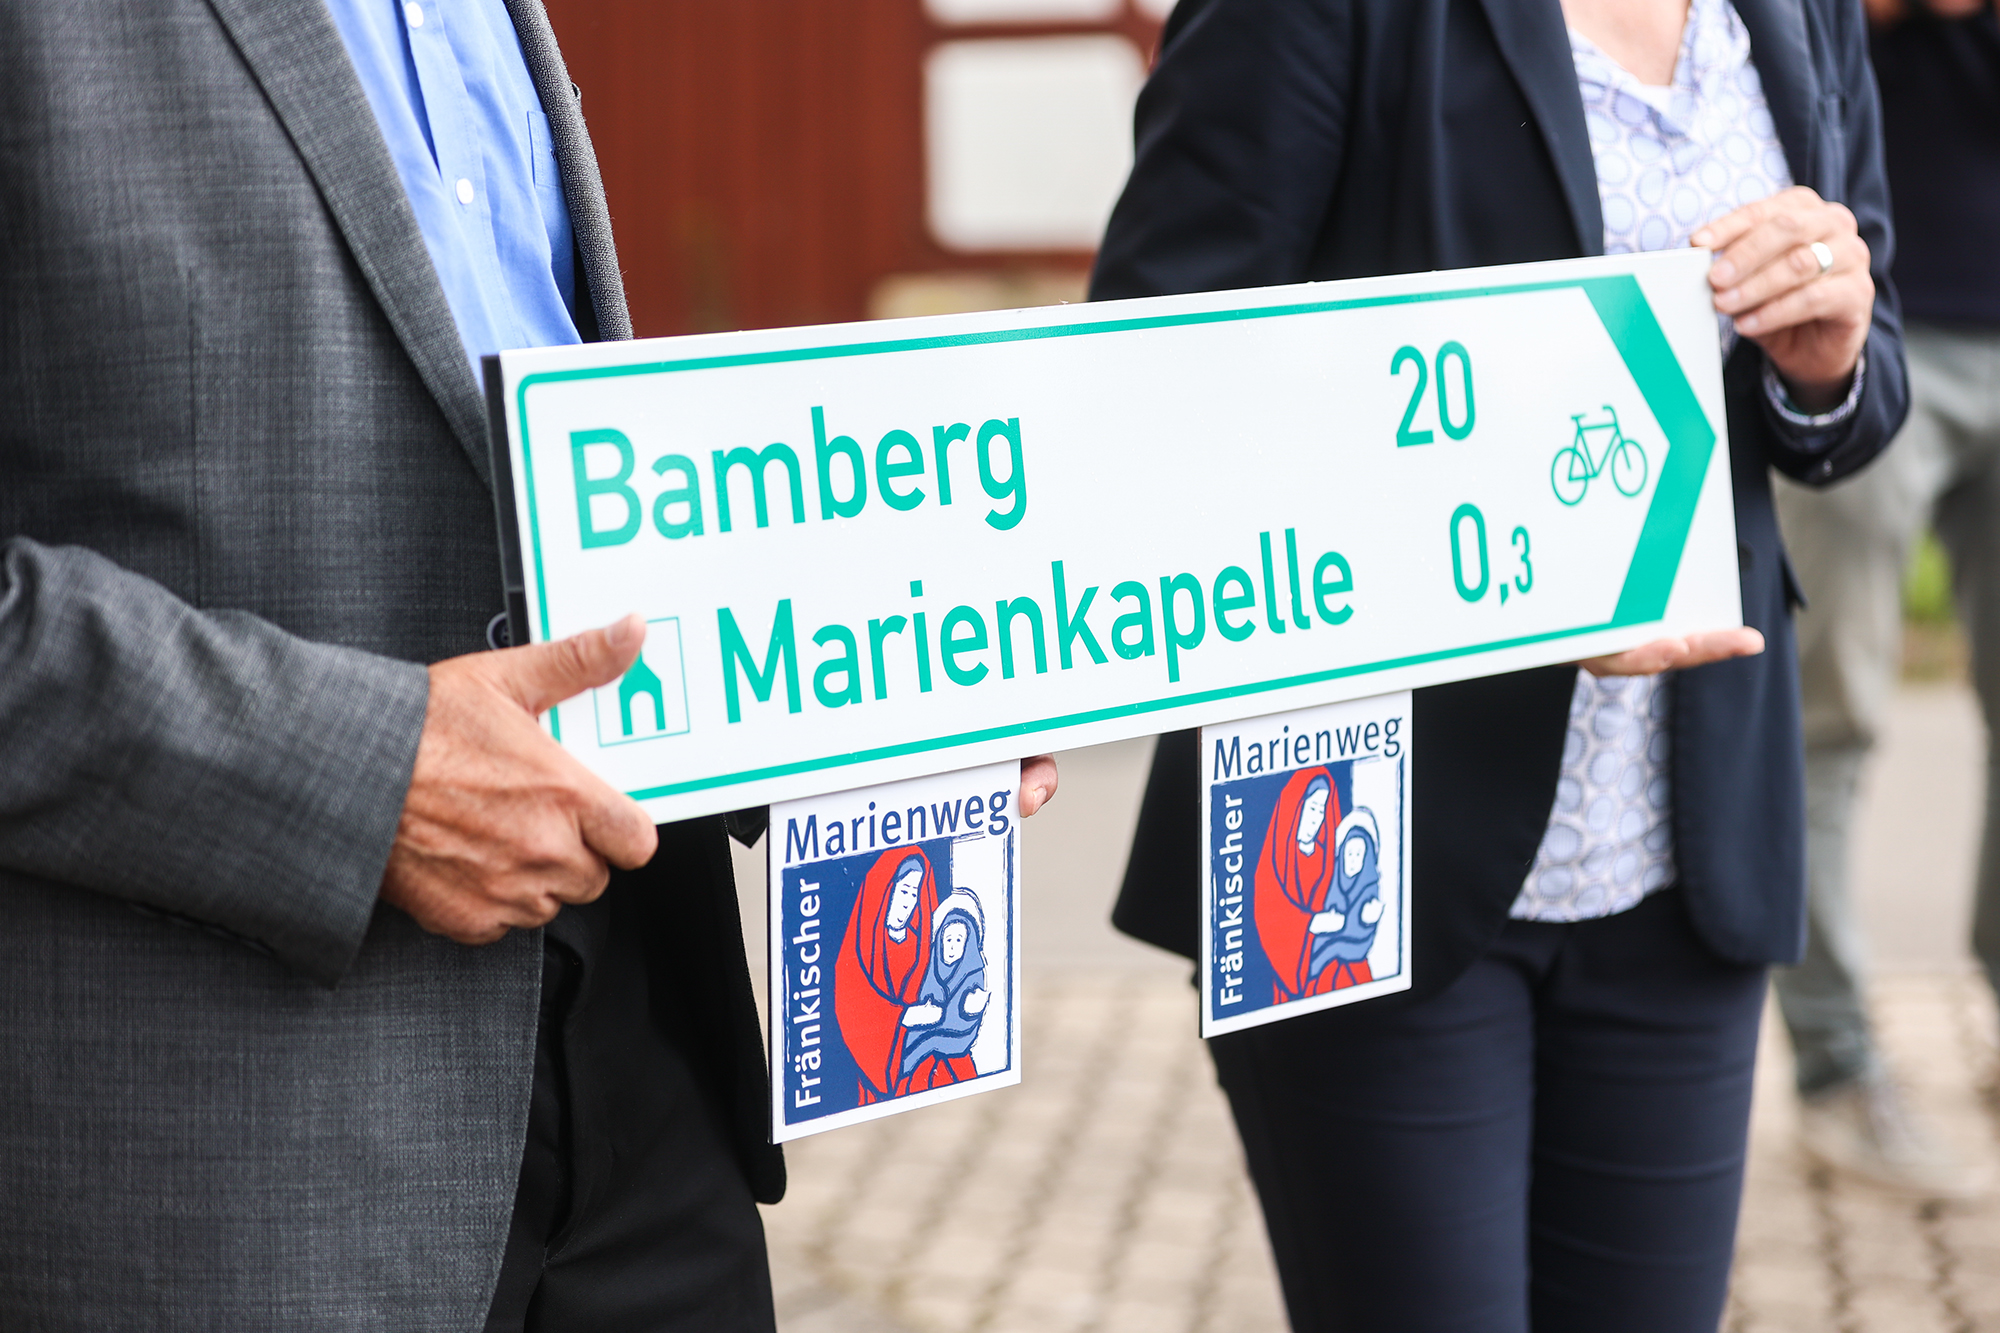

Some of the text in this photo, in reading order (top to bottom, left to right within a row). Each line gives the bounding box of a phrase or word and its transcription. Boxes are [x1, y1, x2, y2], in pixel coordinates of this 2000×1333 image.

[568, 340, 1477, 550] Bamberg 20
[716, 527, 1355, 724] Marienkapelle
[785, 789, 1013, 863] Marienweg
[1213, 716, 1403, 782] Marienweg
[792, 878, 822, 1109] Fränkischer
[1218, 793, 1244, 1007] Fränkischer
